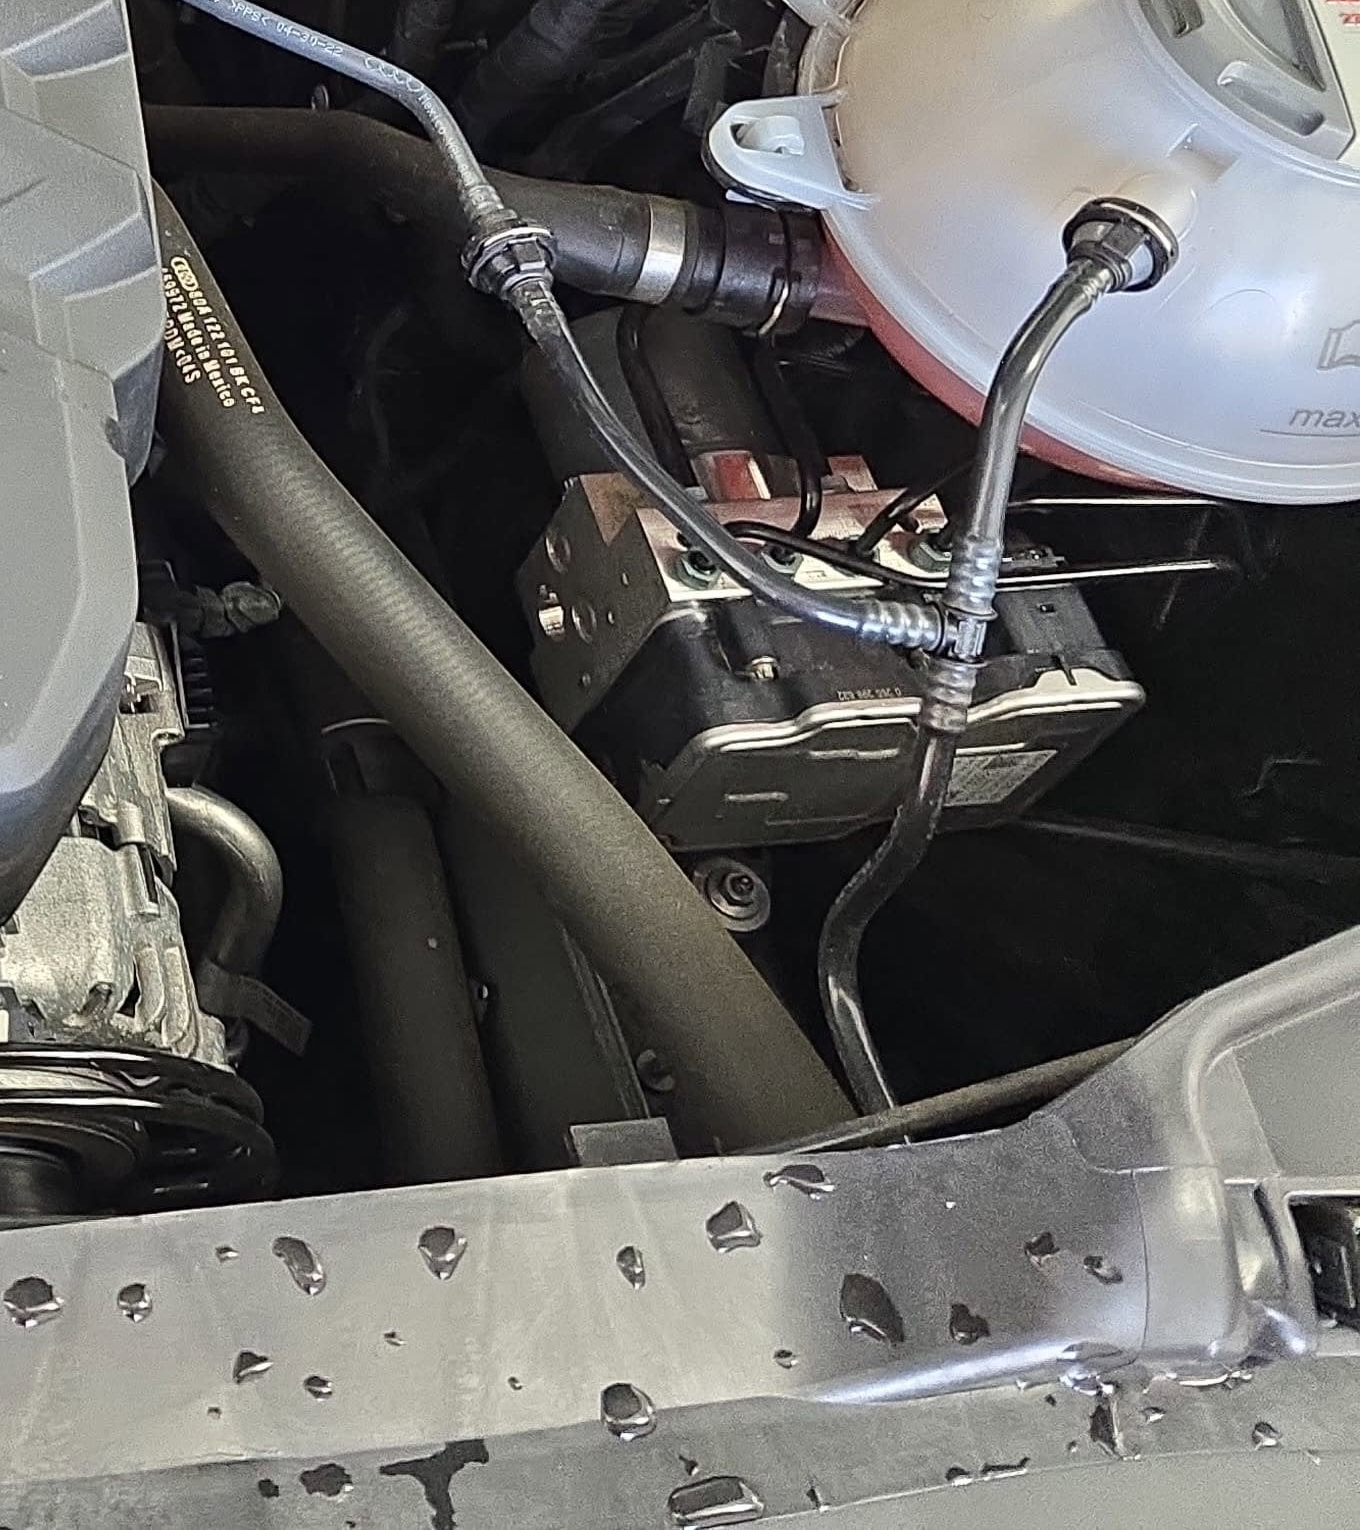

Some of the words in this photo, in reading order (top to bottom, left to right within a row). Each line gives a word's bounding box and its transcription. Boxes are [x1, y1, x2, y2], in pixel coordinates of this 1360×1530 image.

[177, 310, 204, 347] Made
[202, 315, 226, 342] 122
[195, 344, 211, 361] in
[202, 359, 236, 408] Mexico
[1288, 409, 1360, 428] max
